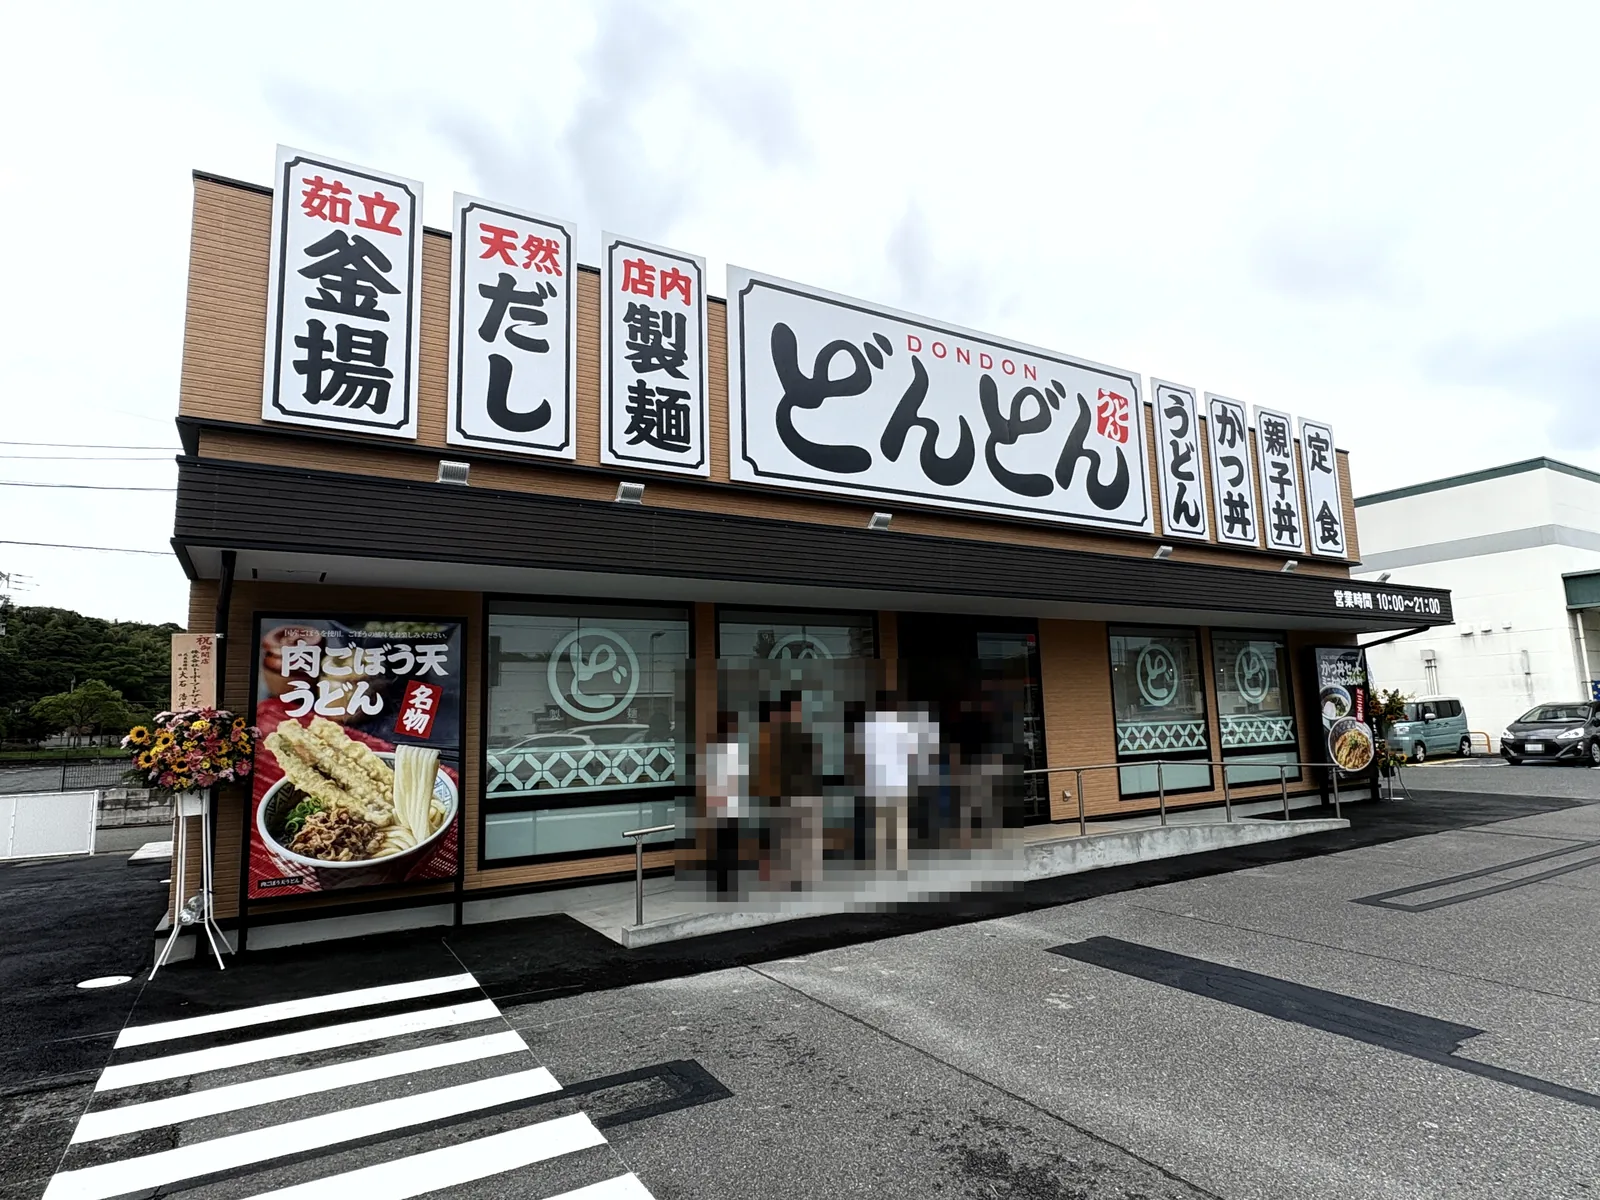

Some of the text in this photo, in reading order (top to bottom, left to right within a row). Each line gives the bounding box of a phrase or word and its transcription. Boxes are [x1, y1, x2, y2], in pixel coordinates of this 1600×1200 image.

[301, 175, 402, 236] 茹立
[478, 222, 563, 277] 天然
[621, 257, 692, 307] 店内
[292, 229, 401, 415] 釜揚
[478, 272, 557, 432] だし
[622, 303, 692, 453] 製麺
[906, 334, 1038, 381] DONDON
[771, 322, 1129, 511] どんどん
[1097, 388, 1128, 440] うどん
[1162, 393, 1199, 530] うどん
[1215, 405, 1250, 539] かつ丼
[1263, 418, 1297, 544] 親子丼
[1307, 432, 1339, 546] 定食
[1333, 590, 1373, 609] 営業時間
[281, 640, 449, 677] 肉ごぼう天
[279, 680, 384, 717] うどん
[402, 684, 434, 734] 名物
